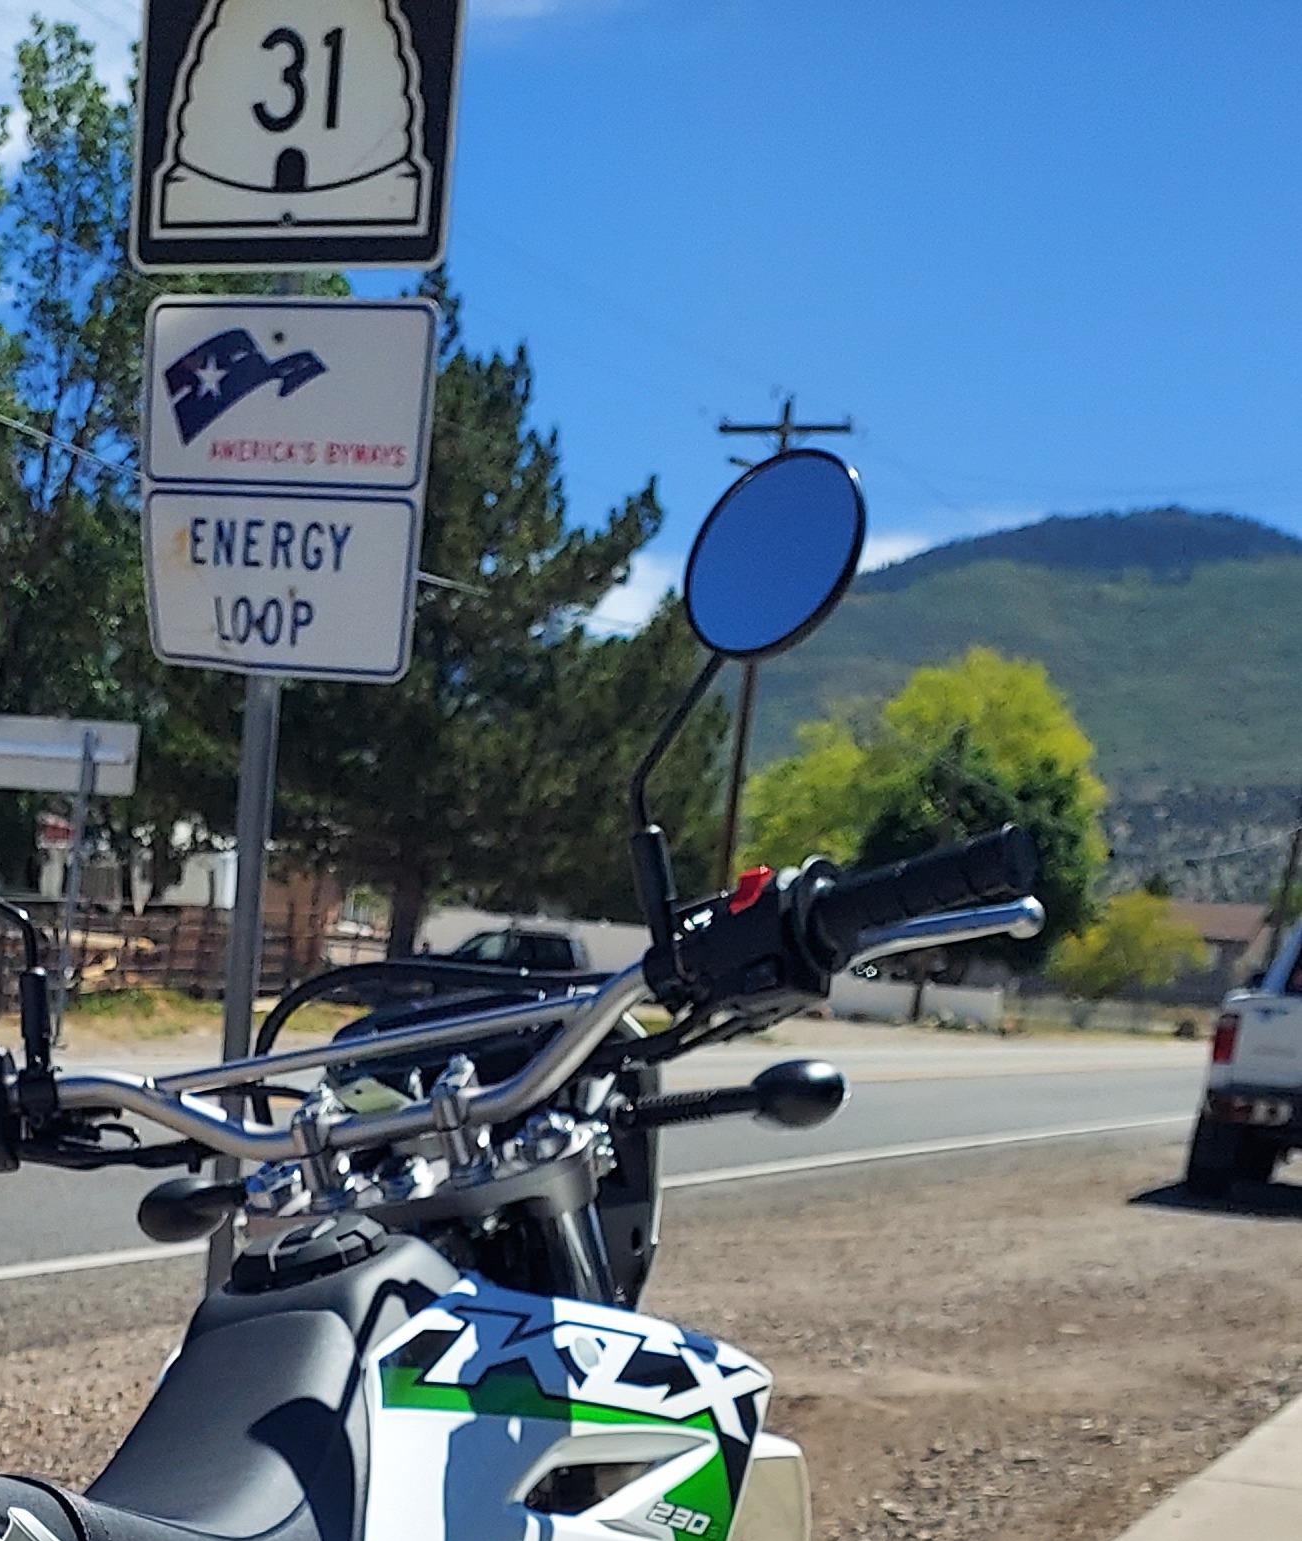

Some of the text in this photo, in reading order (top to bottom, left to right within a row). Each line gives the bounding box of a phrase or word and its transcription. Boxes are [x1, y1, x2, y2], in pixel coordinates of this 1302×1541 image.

[252, 27, 343, 132] 31
[209, 439, 406, 468] AMERICA'S BYWAYS
[190, 518, 352, 572] ENERGY
[214, 596, 315, 648] LOOP
[416, 1306, 770, 1446] KLX
[646, 1501, 712, 1536] 230
